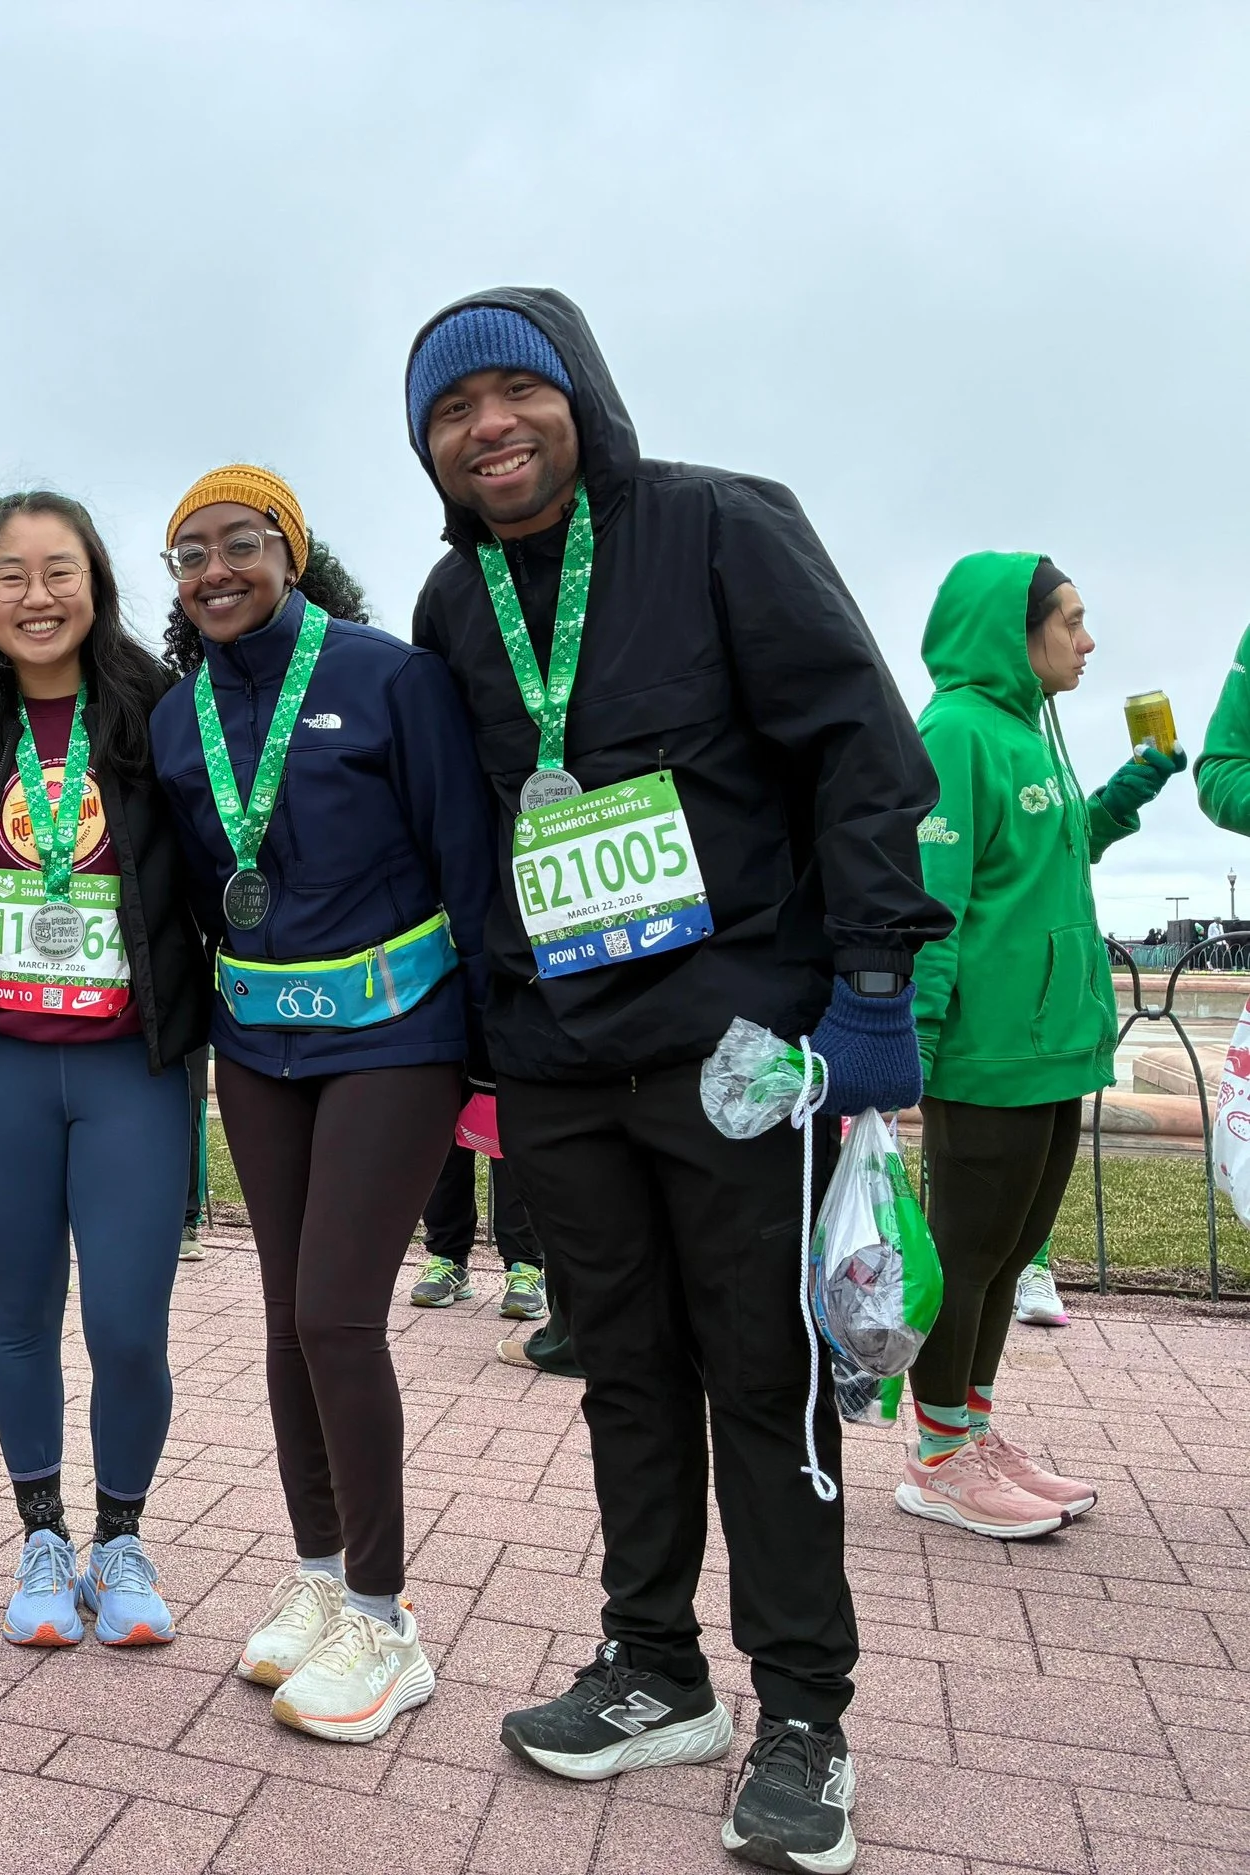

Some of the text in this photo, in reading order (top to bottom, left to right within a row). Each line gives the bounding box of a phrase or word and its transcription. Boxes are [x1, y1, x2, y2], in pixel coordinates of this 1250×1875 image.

[538, 812, 562, 824] BANK
[564, 807, 574, 816] OF
[576, 796, 617, 812] AMERICA
[541, 797, 652, 838] SHAMROCK SHUFFLE
[12, 814, 33, 842] RE
[539, 822, 688, 908] 21005
[75, 890, 116, 902] SHUFFLE
[522, 870, 544, 912] E
[567, 893, 643, 920] MARCH 22, 2026
[11, 912, 125, 962] 164
[645, 918, 673, 936] RUN
[685, 927, 692, 936] 3
[18, 960, 86, 972] MARCH 22, 2026
[548, 944, 596, 966] ROW 18
[18, 990, 32, 1002] 10
[78, 990, 102, 1000] RUN
[276, 986, 336, 1018] 606
[926, 1476, 961, 1500] HOKA
[365, 1651, 400, 1696] HOKA
